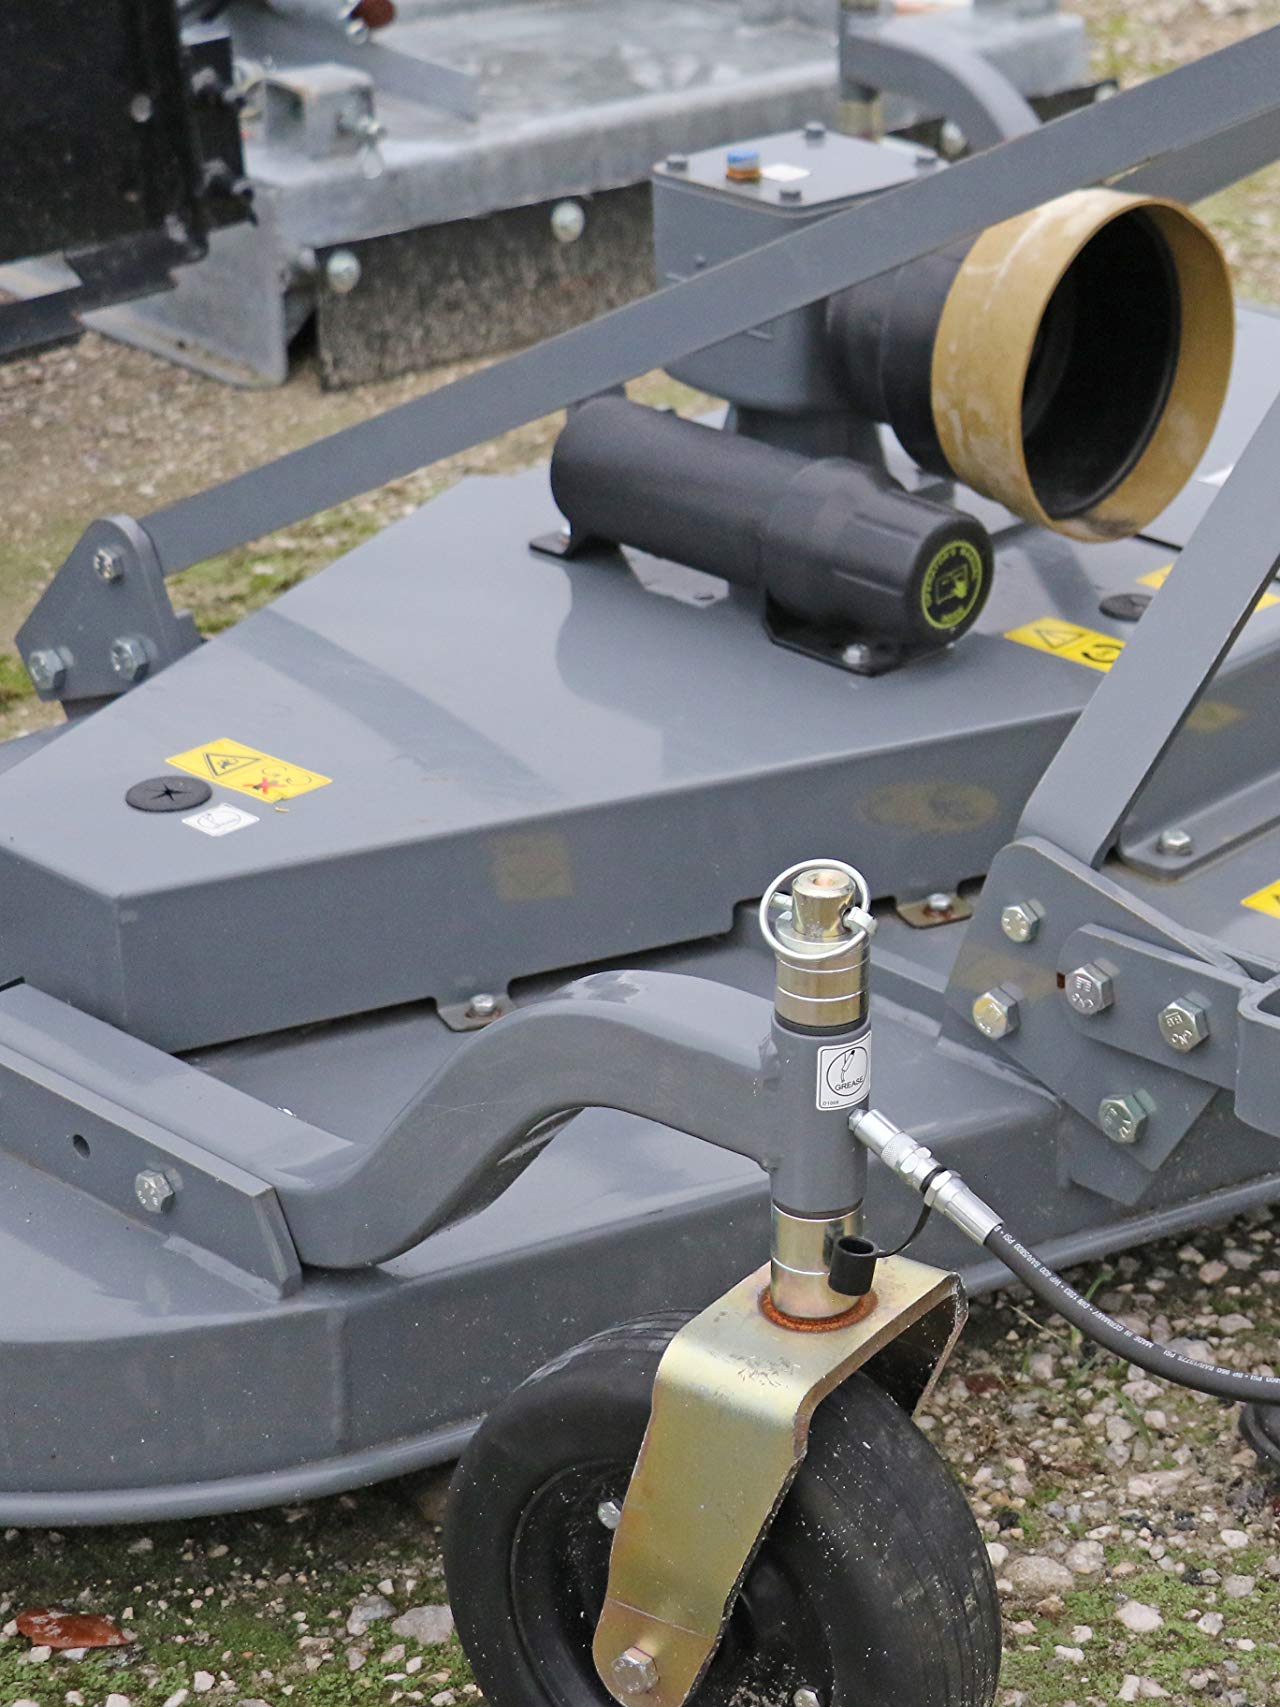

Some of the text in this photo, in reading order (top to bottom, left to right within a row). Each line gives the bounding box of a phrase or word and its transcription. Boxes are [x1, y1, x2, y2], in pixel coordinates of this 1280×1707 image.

[835, 1076, 864, 1091] GREASE
[1002, 1232, 1016, 1245] PSI
[1013, 1242, 1041, 1269] BAR/5800
[1048, 1274, 1062, 1287] WP
[1076, 1297, 1091, 1310] DIN
[1092, 1309, 1125, 1333] GERMANY
[1123, 1328, 1134, 1338] IN
[1132, 1334, 1154, 1350] MADE
[1162, 1349, 1176, 1359] PSI
